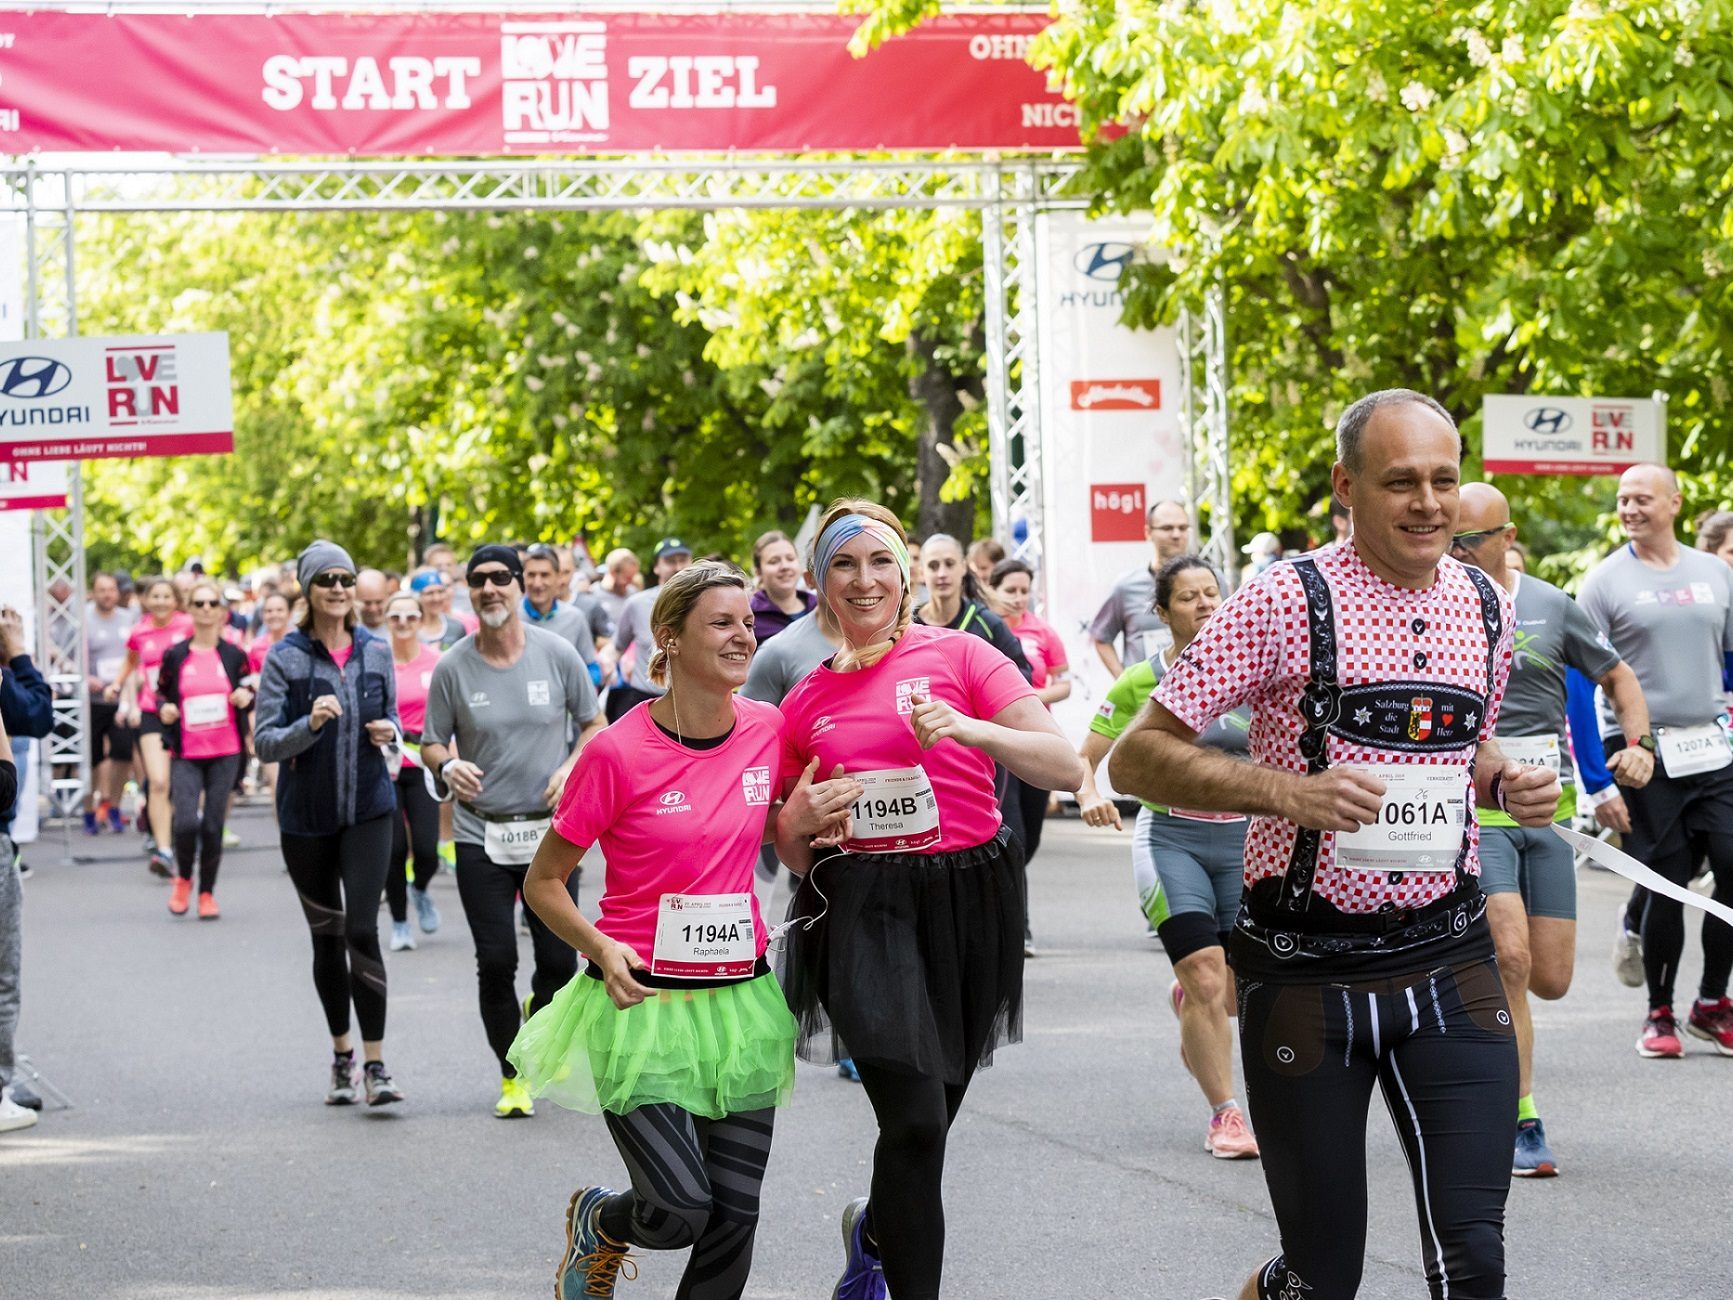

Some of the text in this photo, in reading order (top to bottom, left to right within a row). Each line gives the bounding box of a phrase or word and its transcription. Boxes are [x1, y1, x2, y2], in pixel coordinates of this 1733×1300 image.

[969, 34, 1038, 60] OHN
[262, 55, 480, 110] START
[628, 55, 777, 109] ZIEL
[503, 80, 610, 131] RUN
[1060, 290, 1126, 307] HYUN
[107, 385, 179, 417] RUN
[0, 406, 89, 426] YUNDAI
[1514, 440, 1582, 451] HYUNDAI
[1094, 490, 1142, 514] högl
[1374, 699, 1410, 712] Salzburg
[1440, 702, 1454, 712] mit
[1384, 713, 1398, 722] die
[1379, 724, 1400, 735] Stadt
[1436, 726, 1454, 737] Herz
[1675, 735, 1714, 754] 1207A
[744, 786, 770, 803] RUN
[656, 804, 692, 816] HYUNDAI
[851, 797, 918, 820] 1194B
[869, 822, 904, 831] Theresa
[1387, 830, 1432, 841] Gottfried
[682, 923, 740, 943] 1194A
[693, 947, 730, 957] Raphaela
